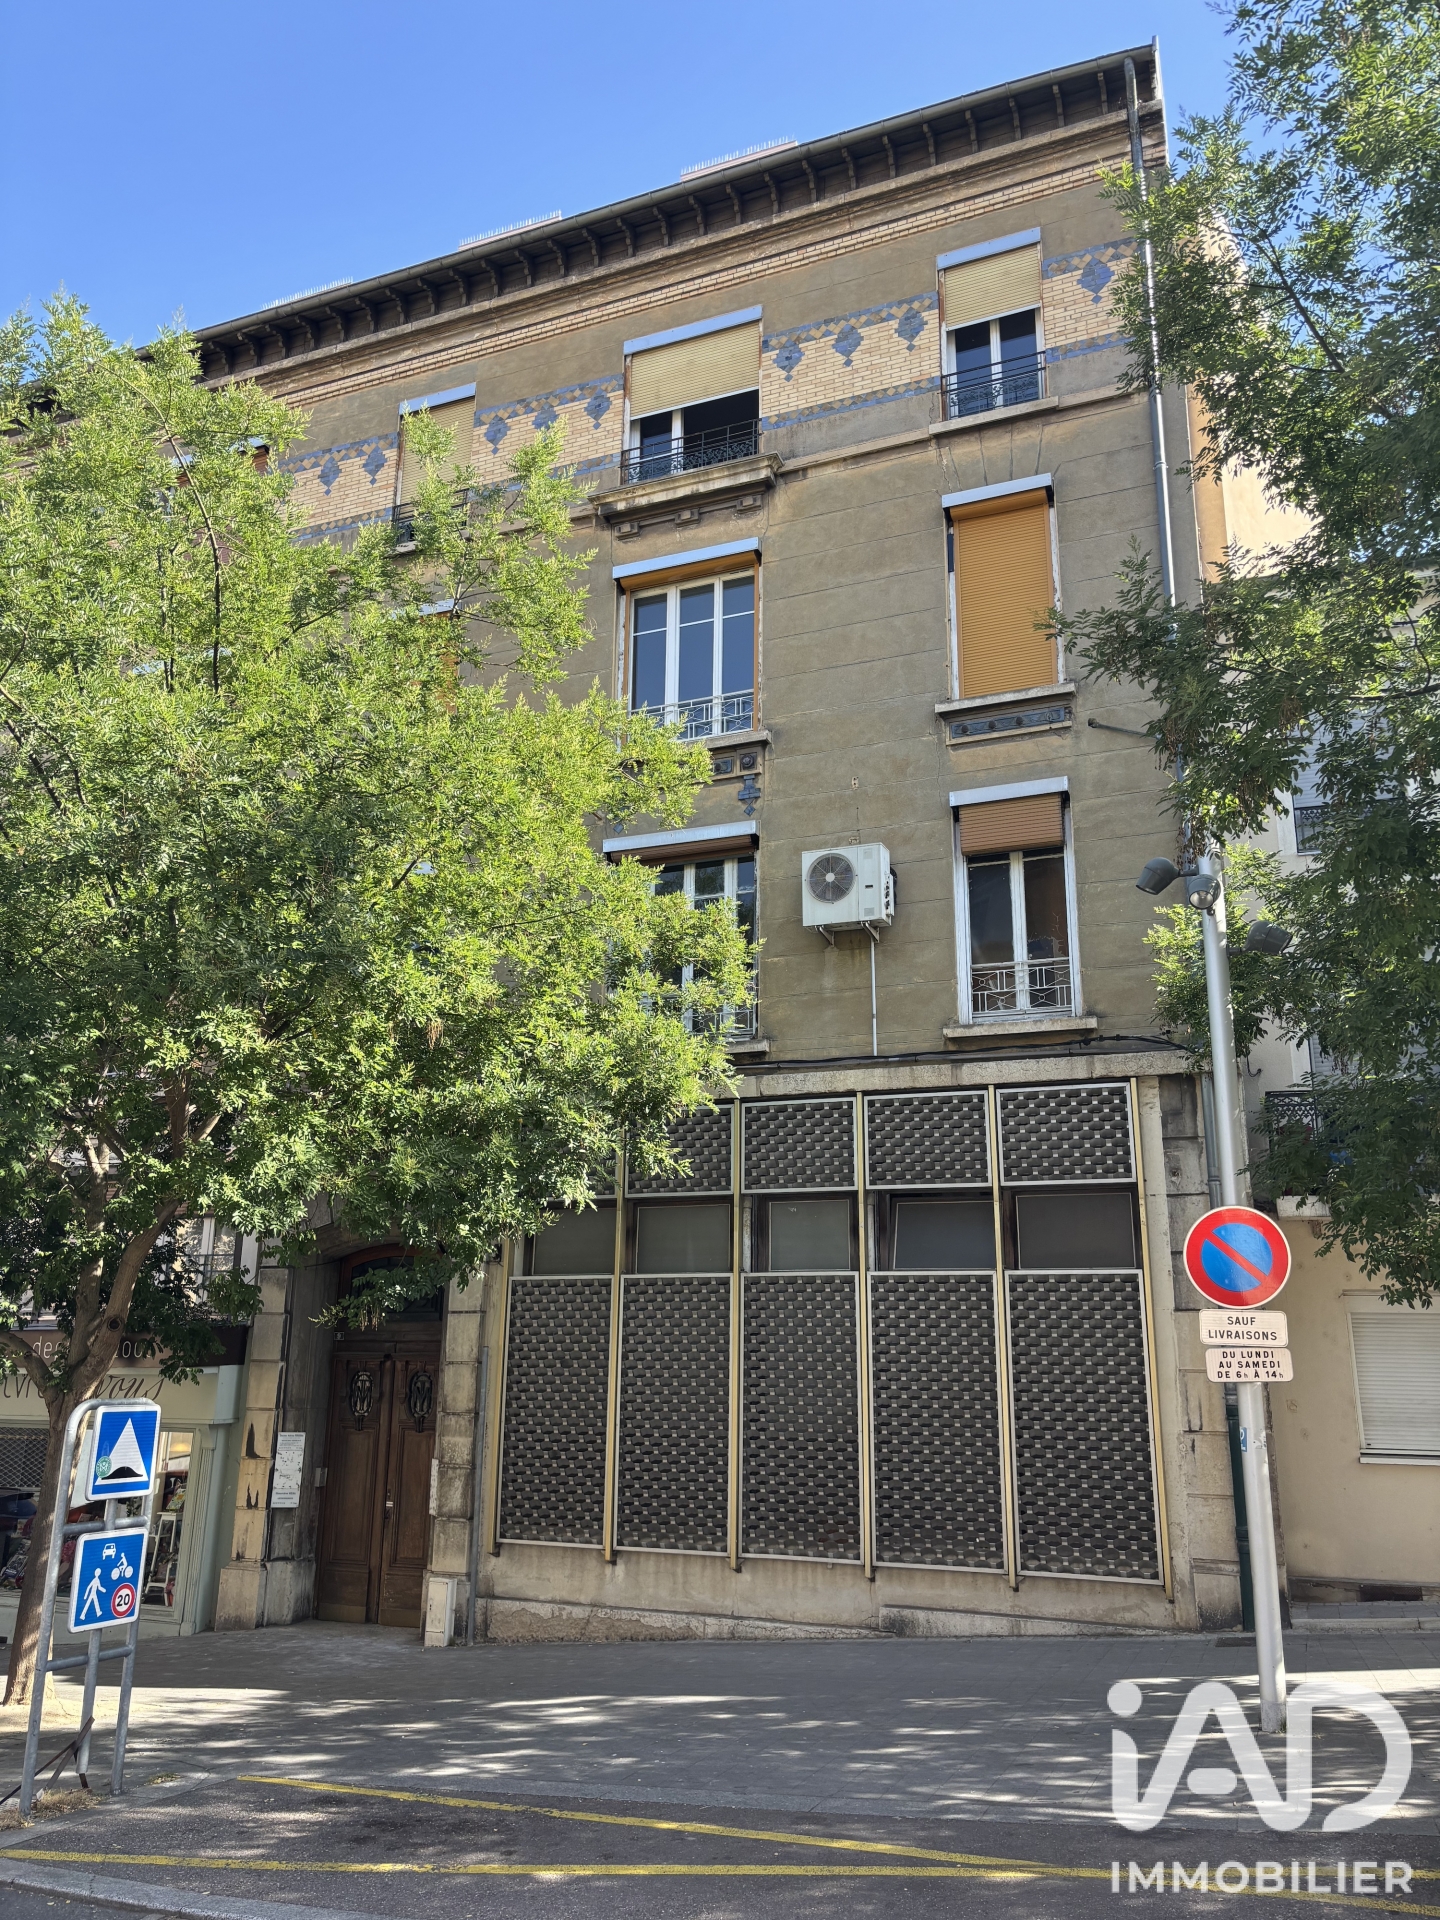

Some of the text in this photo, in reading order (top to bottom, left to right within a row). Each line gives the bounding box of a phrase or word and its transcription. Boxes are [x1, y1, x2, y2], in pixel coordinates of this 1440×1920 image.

[1227, 1316, 1256, 1326] SAUF
[1208, 1330, 1278, 1341] LIVRAISONS
[1222, 1350, 1274, 1359] DU LUNDI
[1218, 1360, 1281, 1369] AU SAMEDI
[1217, 1370, 1231, 1379] DE
[1236, 1370, 1248, 1379] 6h
[1265, 1370, 1283, 1379] 14h
[116, 1593, 130, 1607] 20
